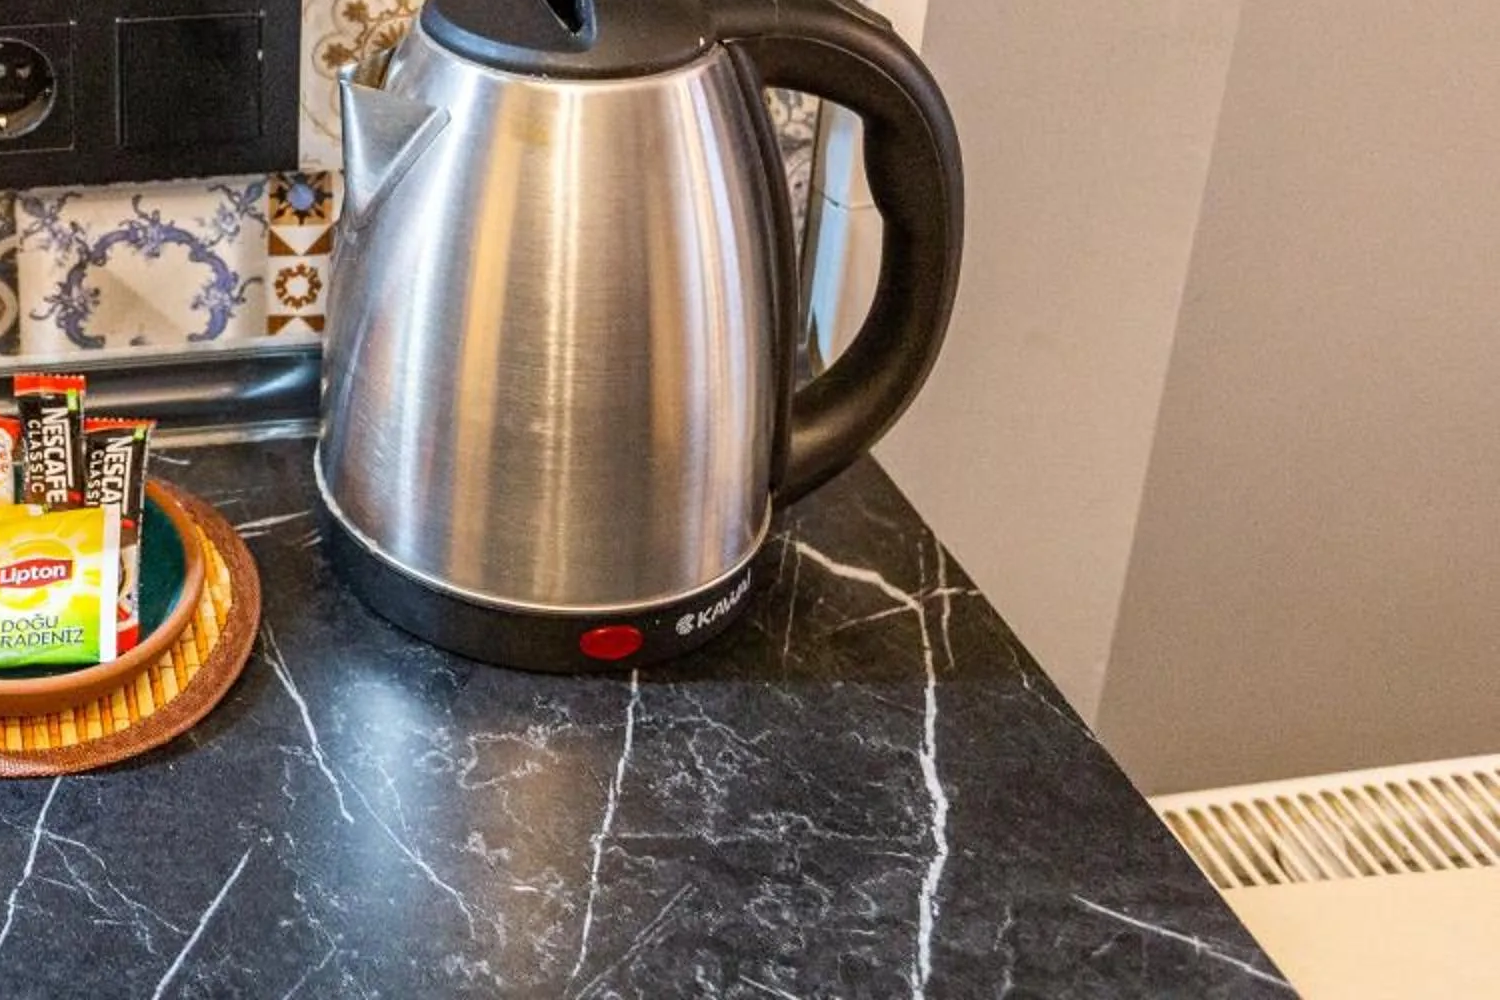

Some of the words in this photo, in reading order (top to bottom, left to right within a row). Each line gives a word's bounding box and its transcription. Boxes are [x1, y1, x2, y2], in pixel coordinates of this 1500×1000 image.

[26, 419, 46, 494] CLASSIC
[86, 449, 105, 506] CLASSI
[100, 435, 133, 506] NESCA
[0, 563, 66, 583] Lipton
[1, 613, 59, 634] DOĞU
